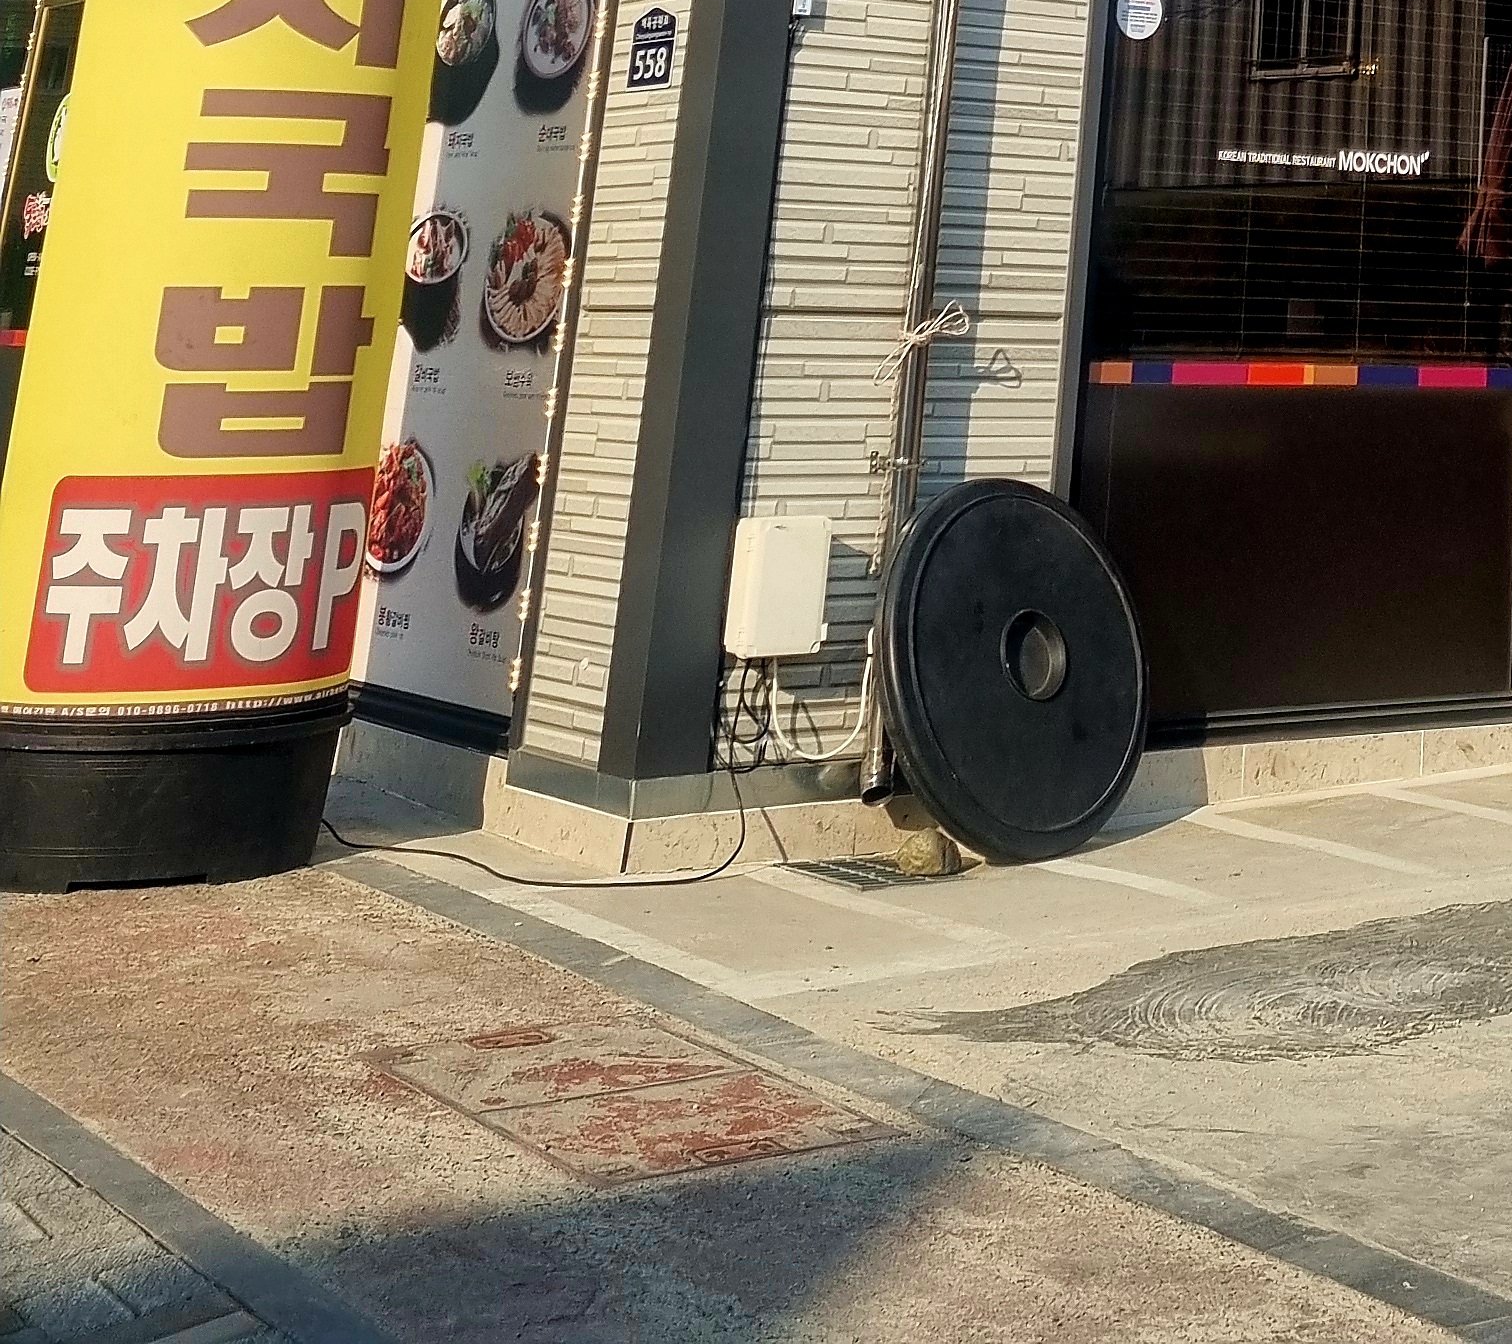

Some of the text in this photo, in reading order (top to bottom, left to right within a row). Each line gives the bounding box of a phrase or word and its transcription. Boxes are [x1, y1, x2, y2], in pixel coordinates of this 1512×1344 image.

[633, 47, 667, 81] 558
[1218, 150, 1247, 163] KOREAN
[1292, 155, 1336, 168] RESTAURANT
[469, 622, 501, 649] 왕갈비탕
